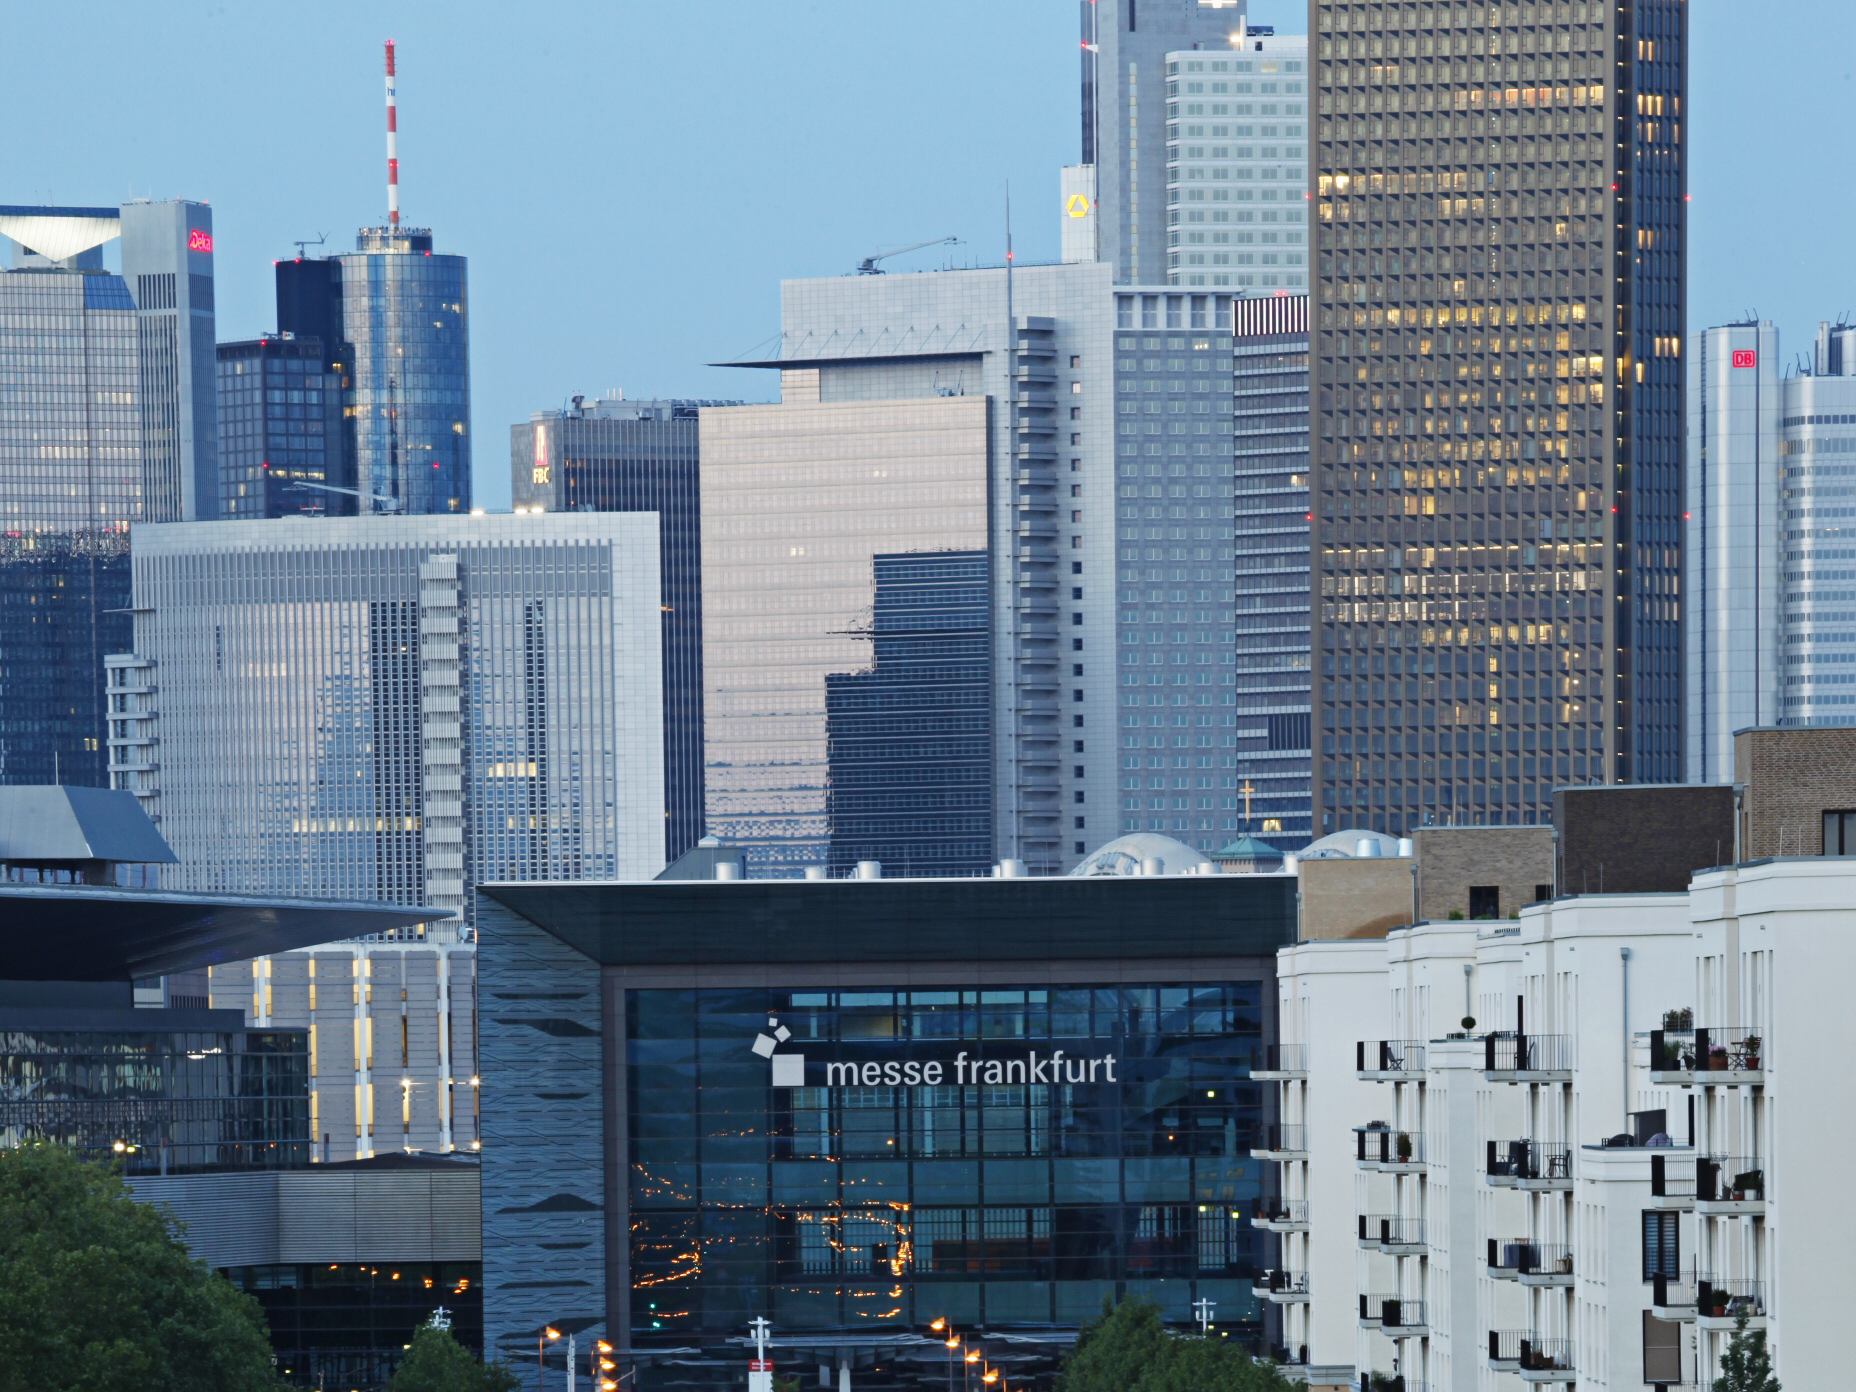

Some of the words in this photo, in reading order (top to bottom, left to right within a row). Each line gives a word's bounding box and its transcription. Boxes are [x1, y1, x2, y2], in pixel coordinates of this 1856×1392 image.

[190, 231, 212, 251] Deka
[1735, 352, 1753, 366] DB
[533, 466, 550, 484] FBC
[827, 1060, 944, 1087] messe
[954, 1050, 1118, 1085] frankfurt
